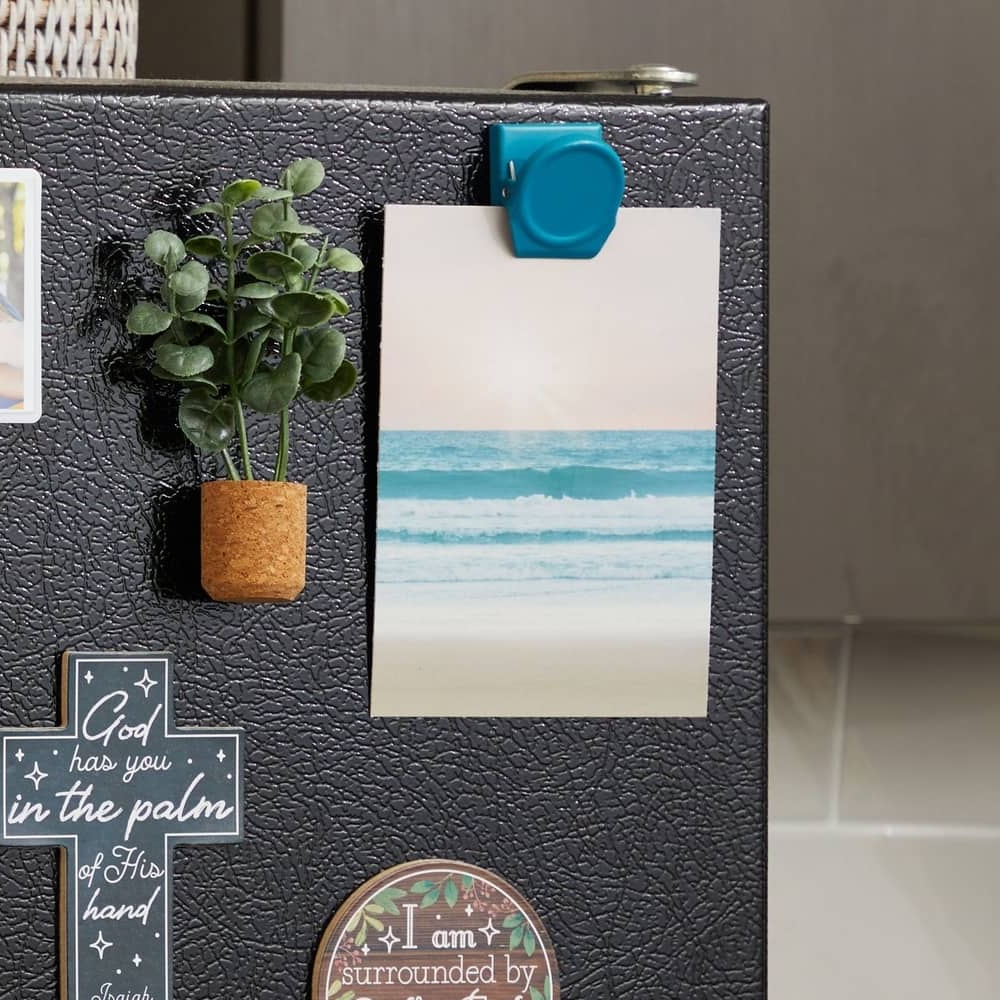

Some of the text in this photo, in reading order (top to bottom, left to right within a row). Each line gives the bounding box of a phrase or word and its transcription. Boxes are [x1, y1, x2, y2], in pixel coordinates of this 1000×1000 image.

[82, 690, 162, 746] God
[69, 745, 171, 782] has you
[7, 773, 234, 840] in the palm
[78, 845, 164, 887] of His
[82, 887, 160, 925] hand
[401, 904, 477, 949] I am
[342, 955, 537, 993] surrounded by
